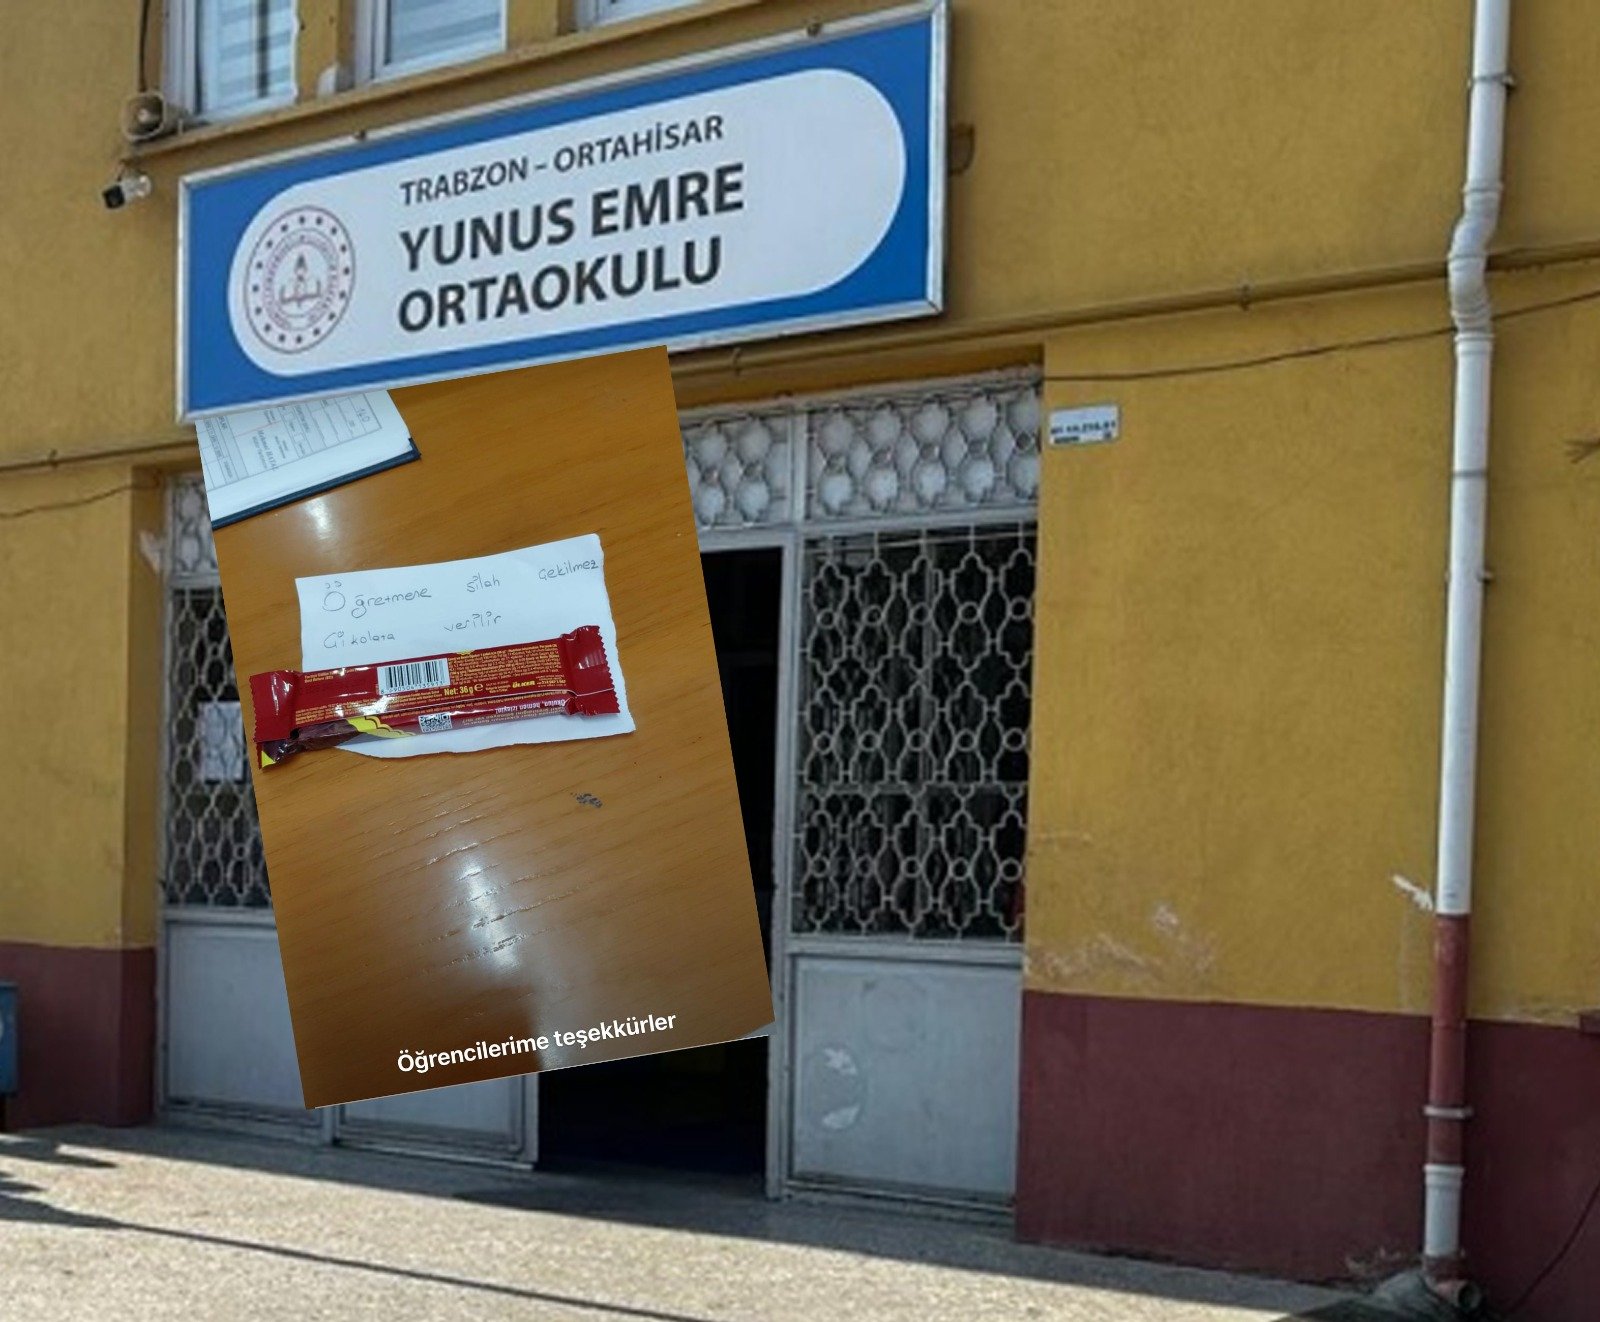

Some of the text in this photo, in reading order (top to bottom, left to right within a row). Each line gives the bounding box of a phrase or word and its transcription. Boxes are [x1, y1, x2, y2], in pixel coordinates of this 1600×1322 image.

[400, 157, 528, 205] TRABZON
[553, 115, 724, 172] ORTAHİSAR
[400, 163, 744, 271] YUNUS EMRE
[398, 236, 721, 332] ORTAOKULU
